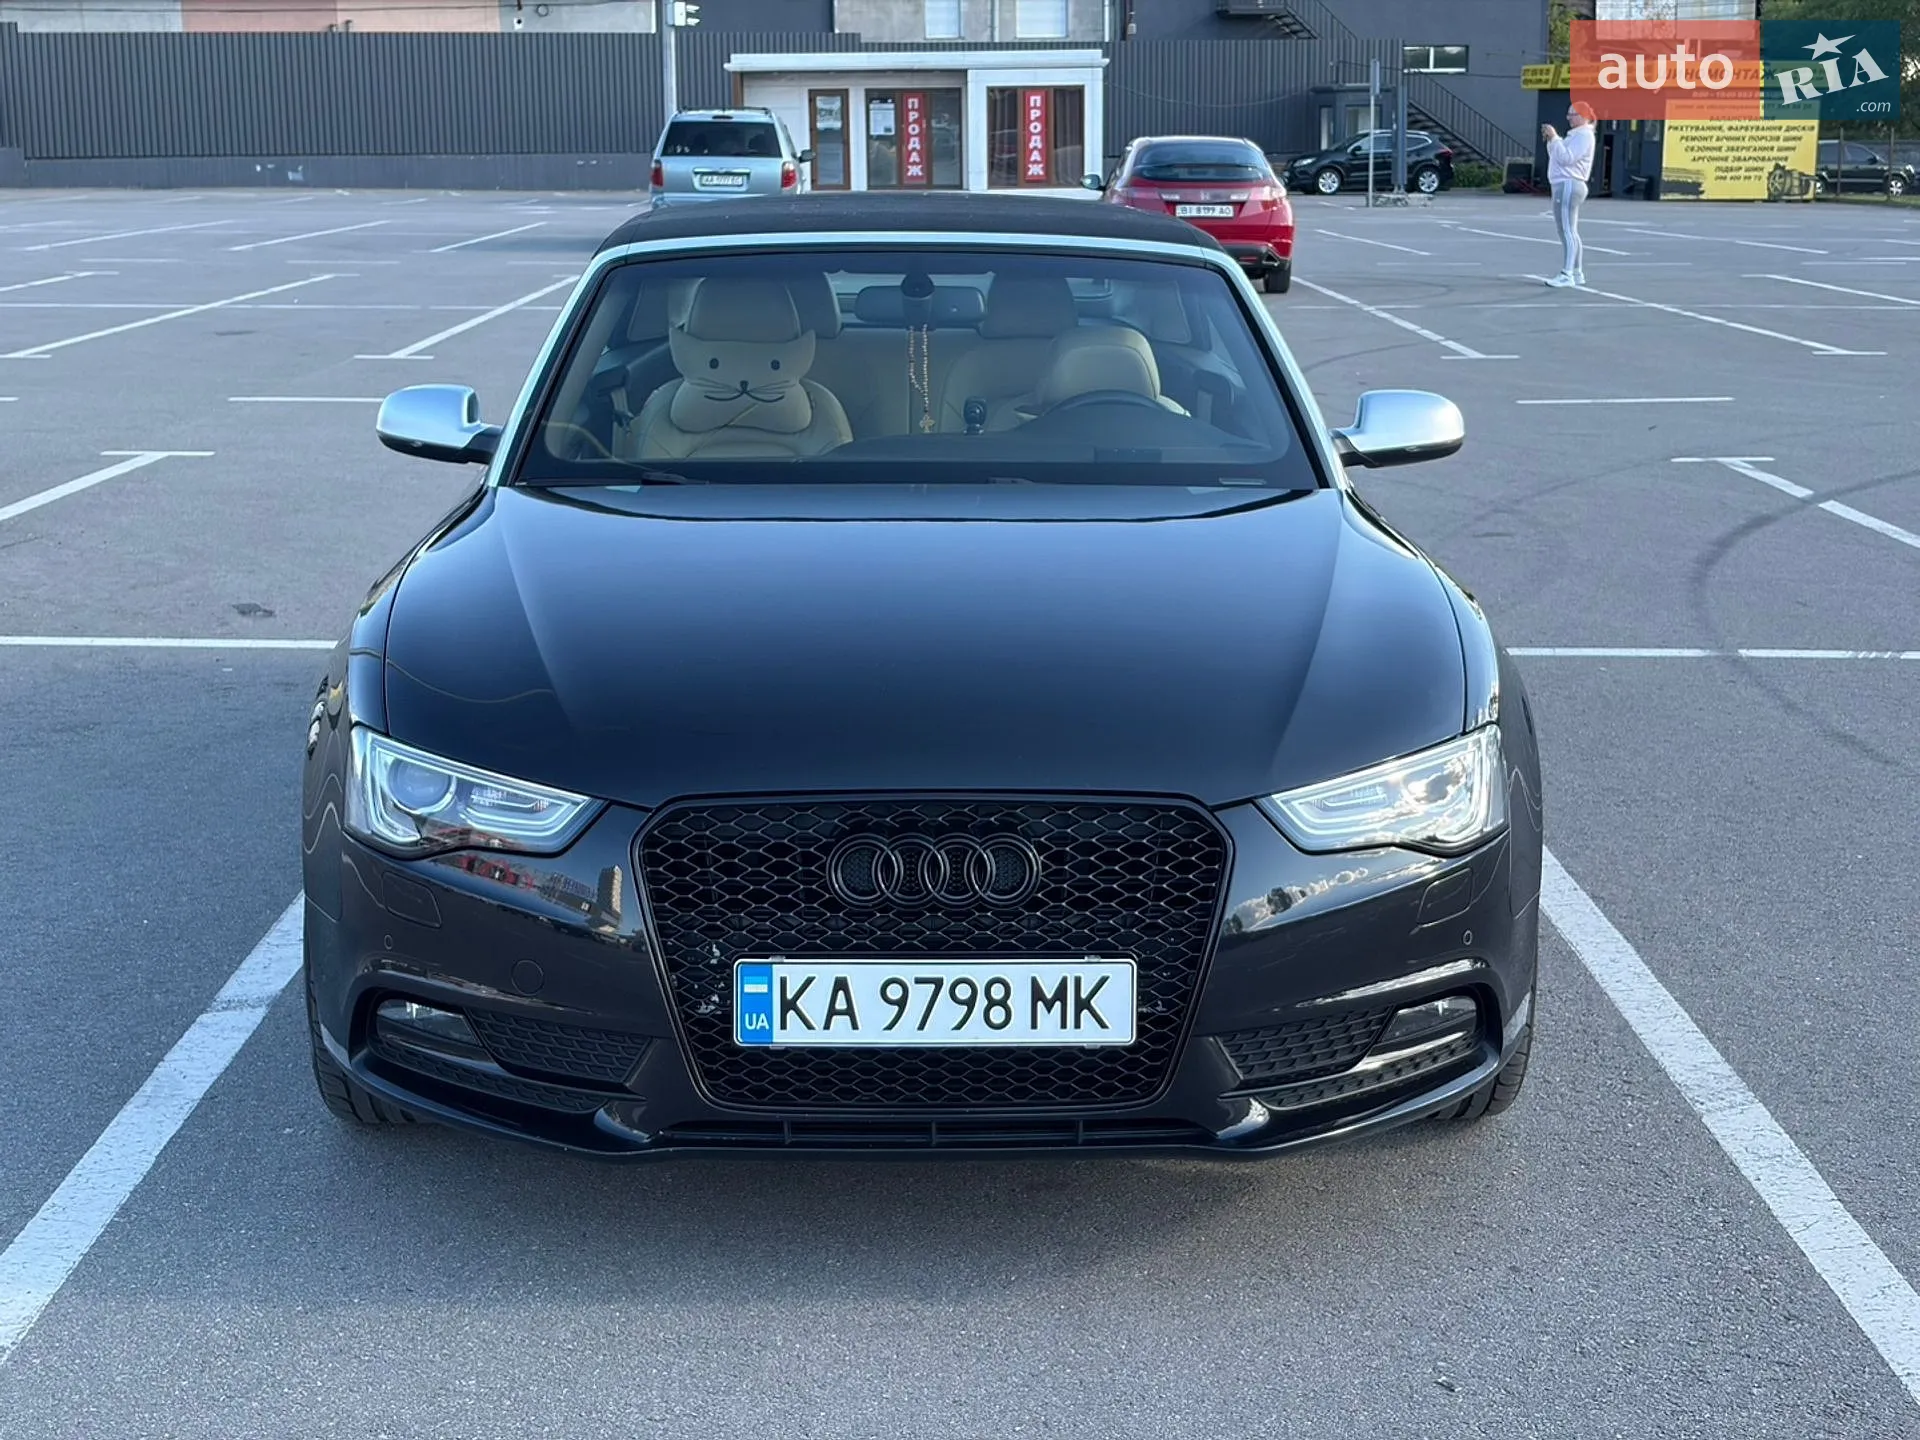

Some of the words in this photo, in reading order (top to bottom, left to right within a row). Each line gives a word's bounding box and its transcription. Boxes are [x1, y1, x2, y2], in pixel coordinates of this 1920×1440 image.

[907, 97, 923, 177] ПРОДАЖ
[1027, 95, 1044, 176] ПРОДАЖ
[744, 1013, 770, 1031] UA
[779, 975, 860, 1032] KA
[879, 975, 1013, 1032] 9798
[1030, 975, 1111, 1031] MK
